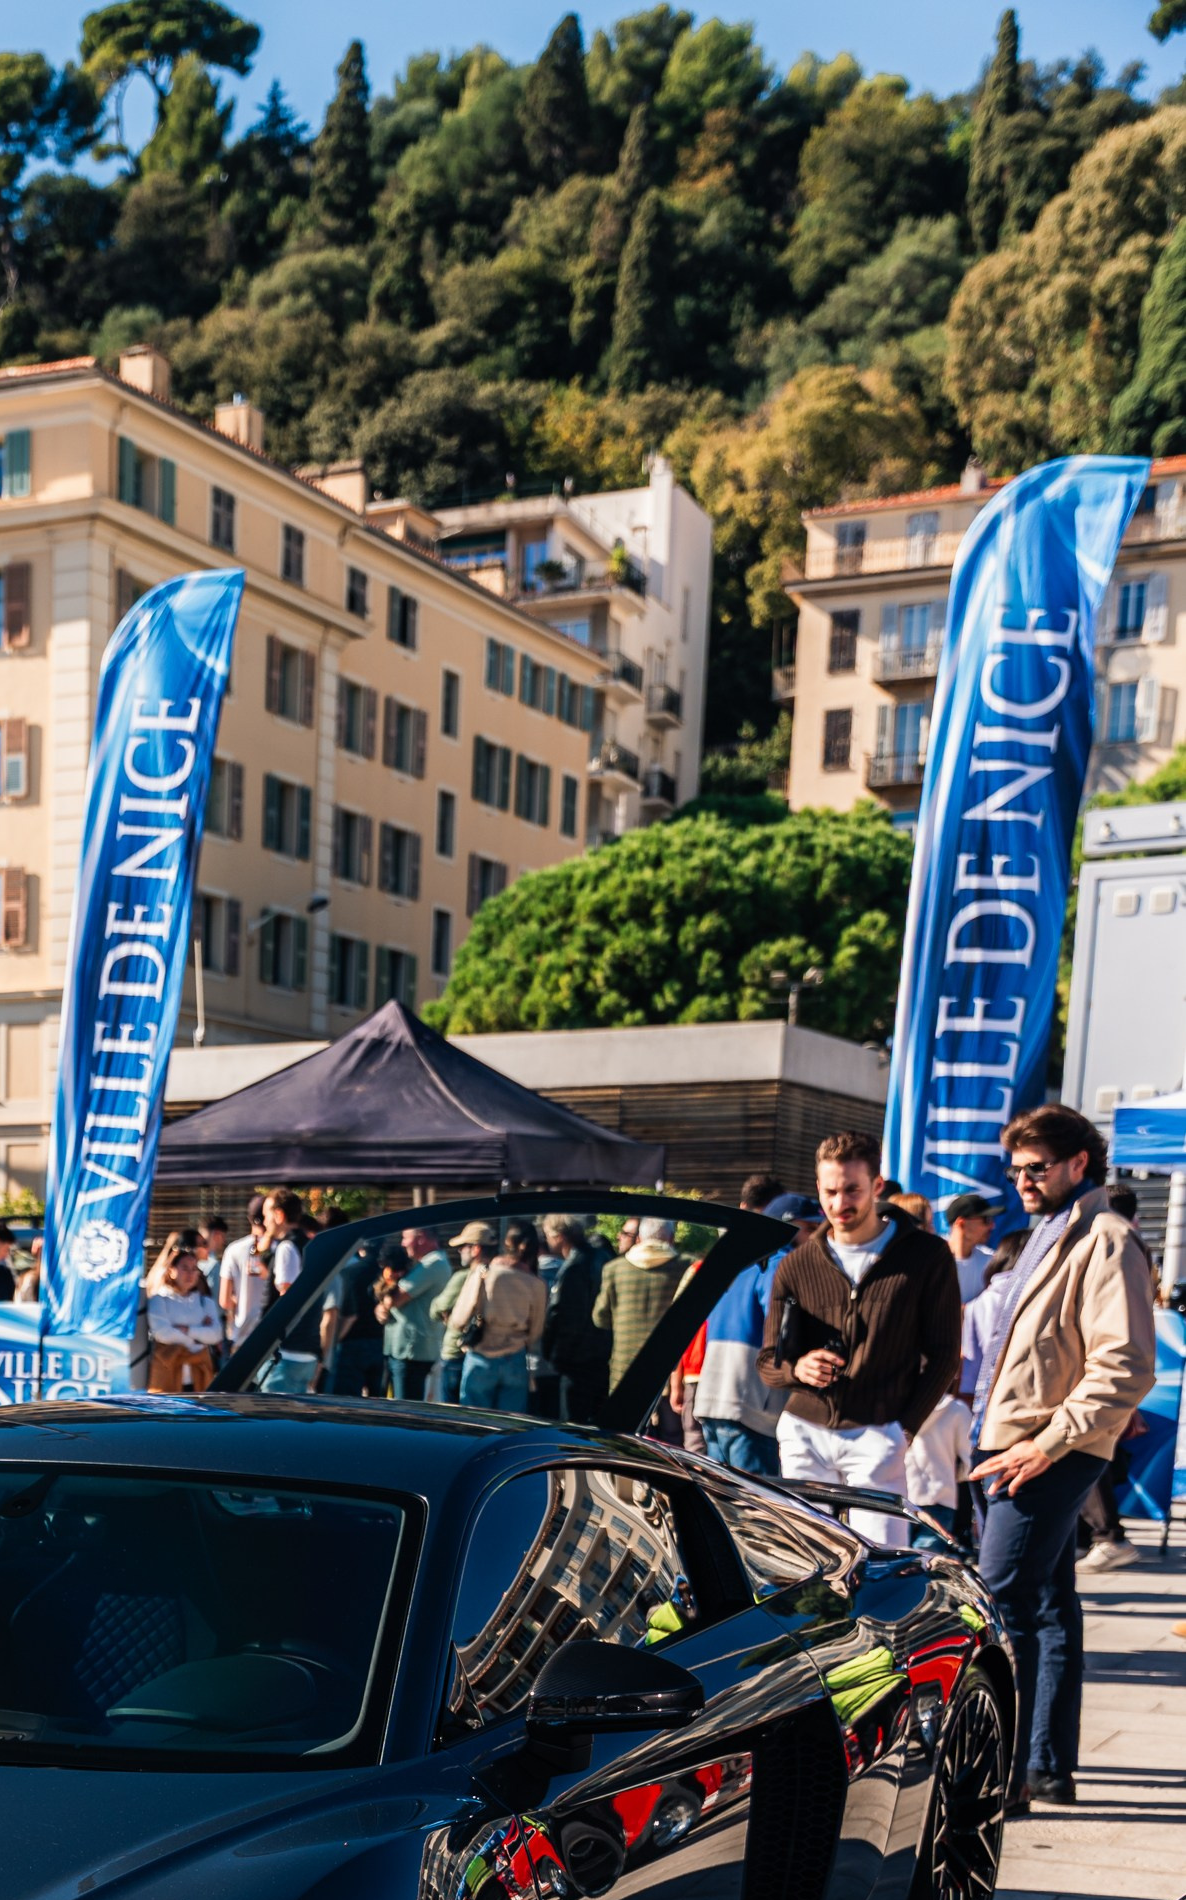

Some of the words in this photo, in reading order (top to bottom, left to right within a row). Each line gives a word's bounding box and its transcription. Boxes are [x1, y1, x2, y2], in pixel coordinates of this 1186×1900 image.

[111, 697, 201, 885] NICE
[961, 606, 1079, 832] NICE
[98, 902, 174, 1003] DE
[943, 853, 1041, 970] DE
[76, 1021, 158, 1212] VILLE
[921, 996, 1026, 1213] VILLE
[71, 1353, 113, 1382] DE
